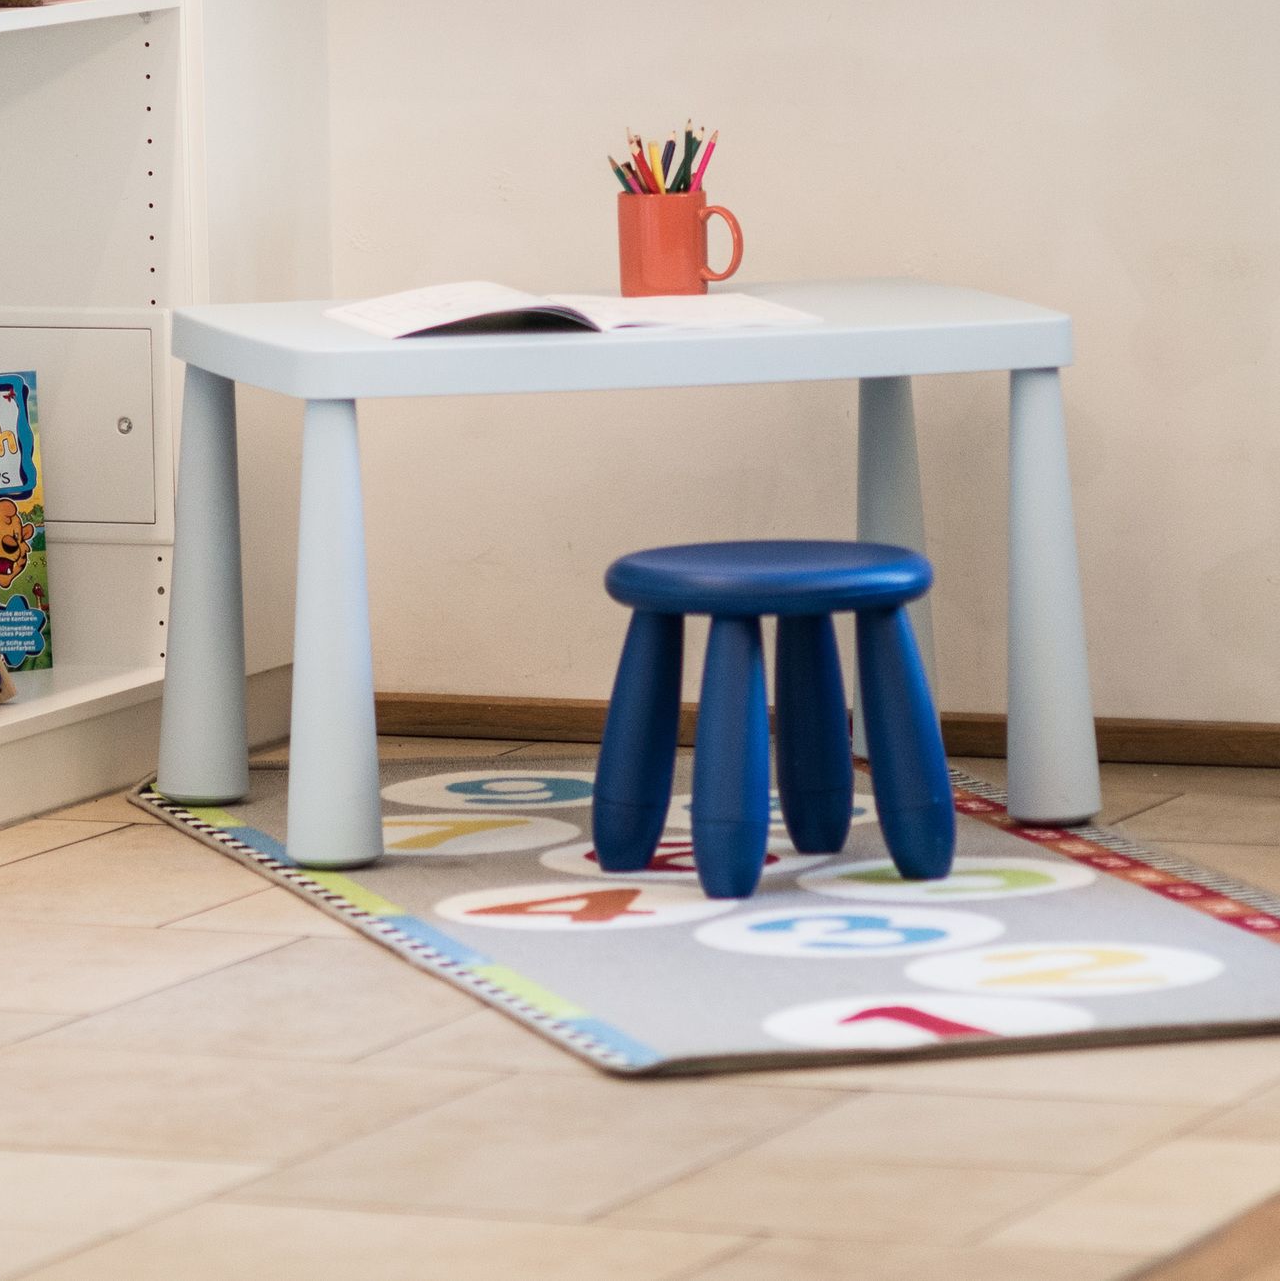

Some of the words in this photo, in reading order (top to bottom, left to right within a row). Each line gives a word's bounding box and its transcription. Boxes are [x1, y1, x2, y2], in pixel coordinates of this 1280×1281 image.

[445, 777, 598, 805] 9
[383, 818, 531, 850] 7
[463, 888, 657, 923] 4
[747, 915, 949, 949] 3
[977, 948, 1169, 987] 2
[838, 1005, 1012, 1038] 1
